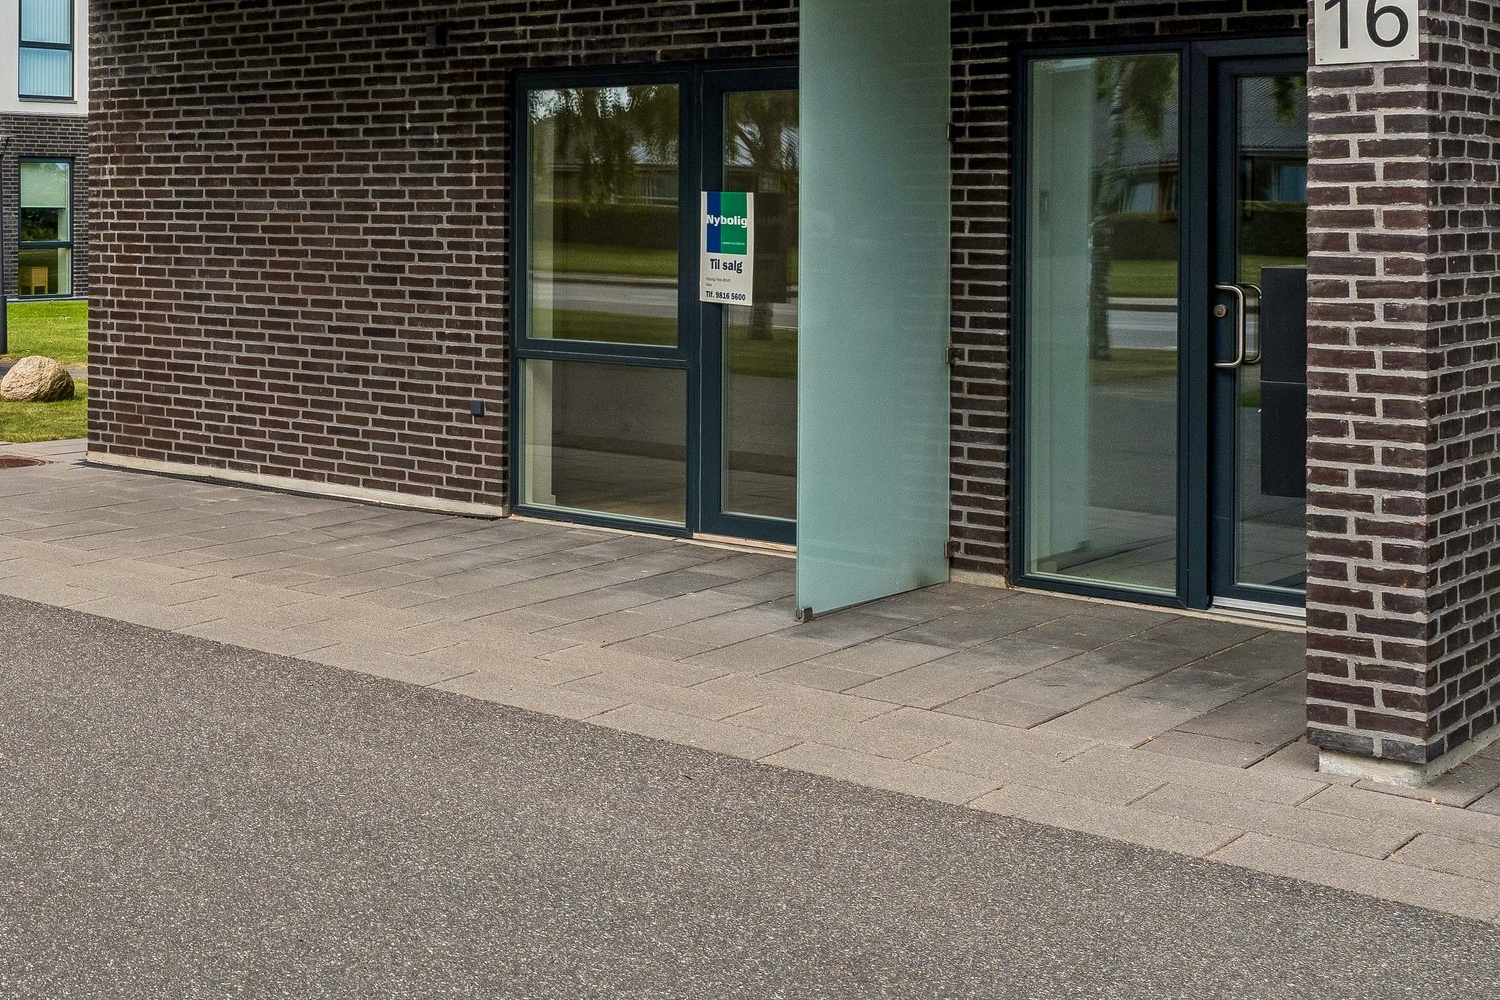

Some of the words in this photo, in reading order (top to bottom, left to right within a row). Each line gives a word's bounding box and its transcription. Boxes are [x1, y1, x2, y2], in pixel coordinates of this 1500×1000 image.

[706, 214, 748, 228] Nybolig
[710, 258, 720, 270] Til
[722, 260, 743, 274] salg
[705, 290, 715, 298] Tlf.
